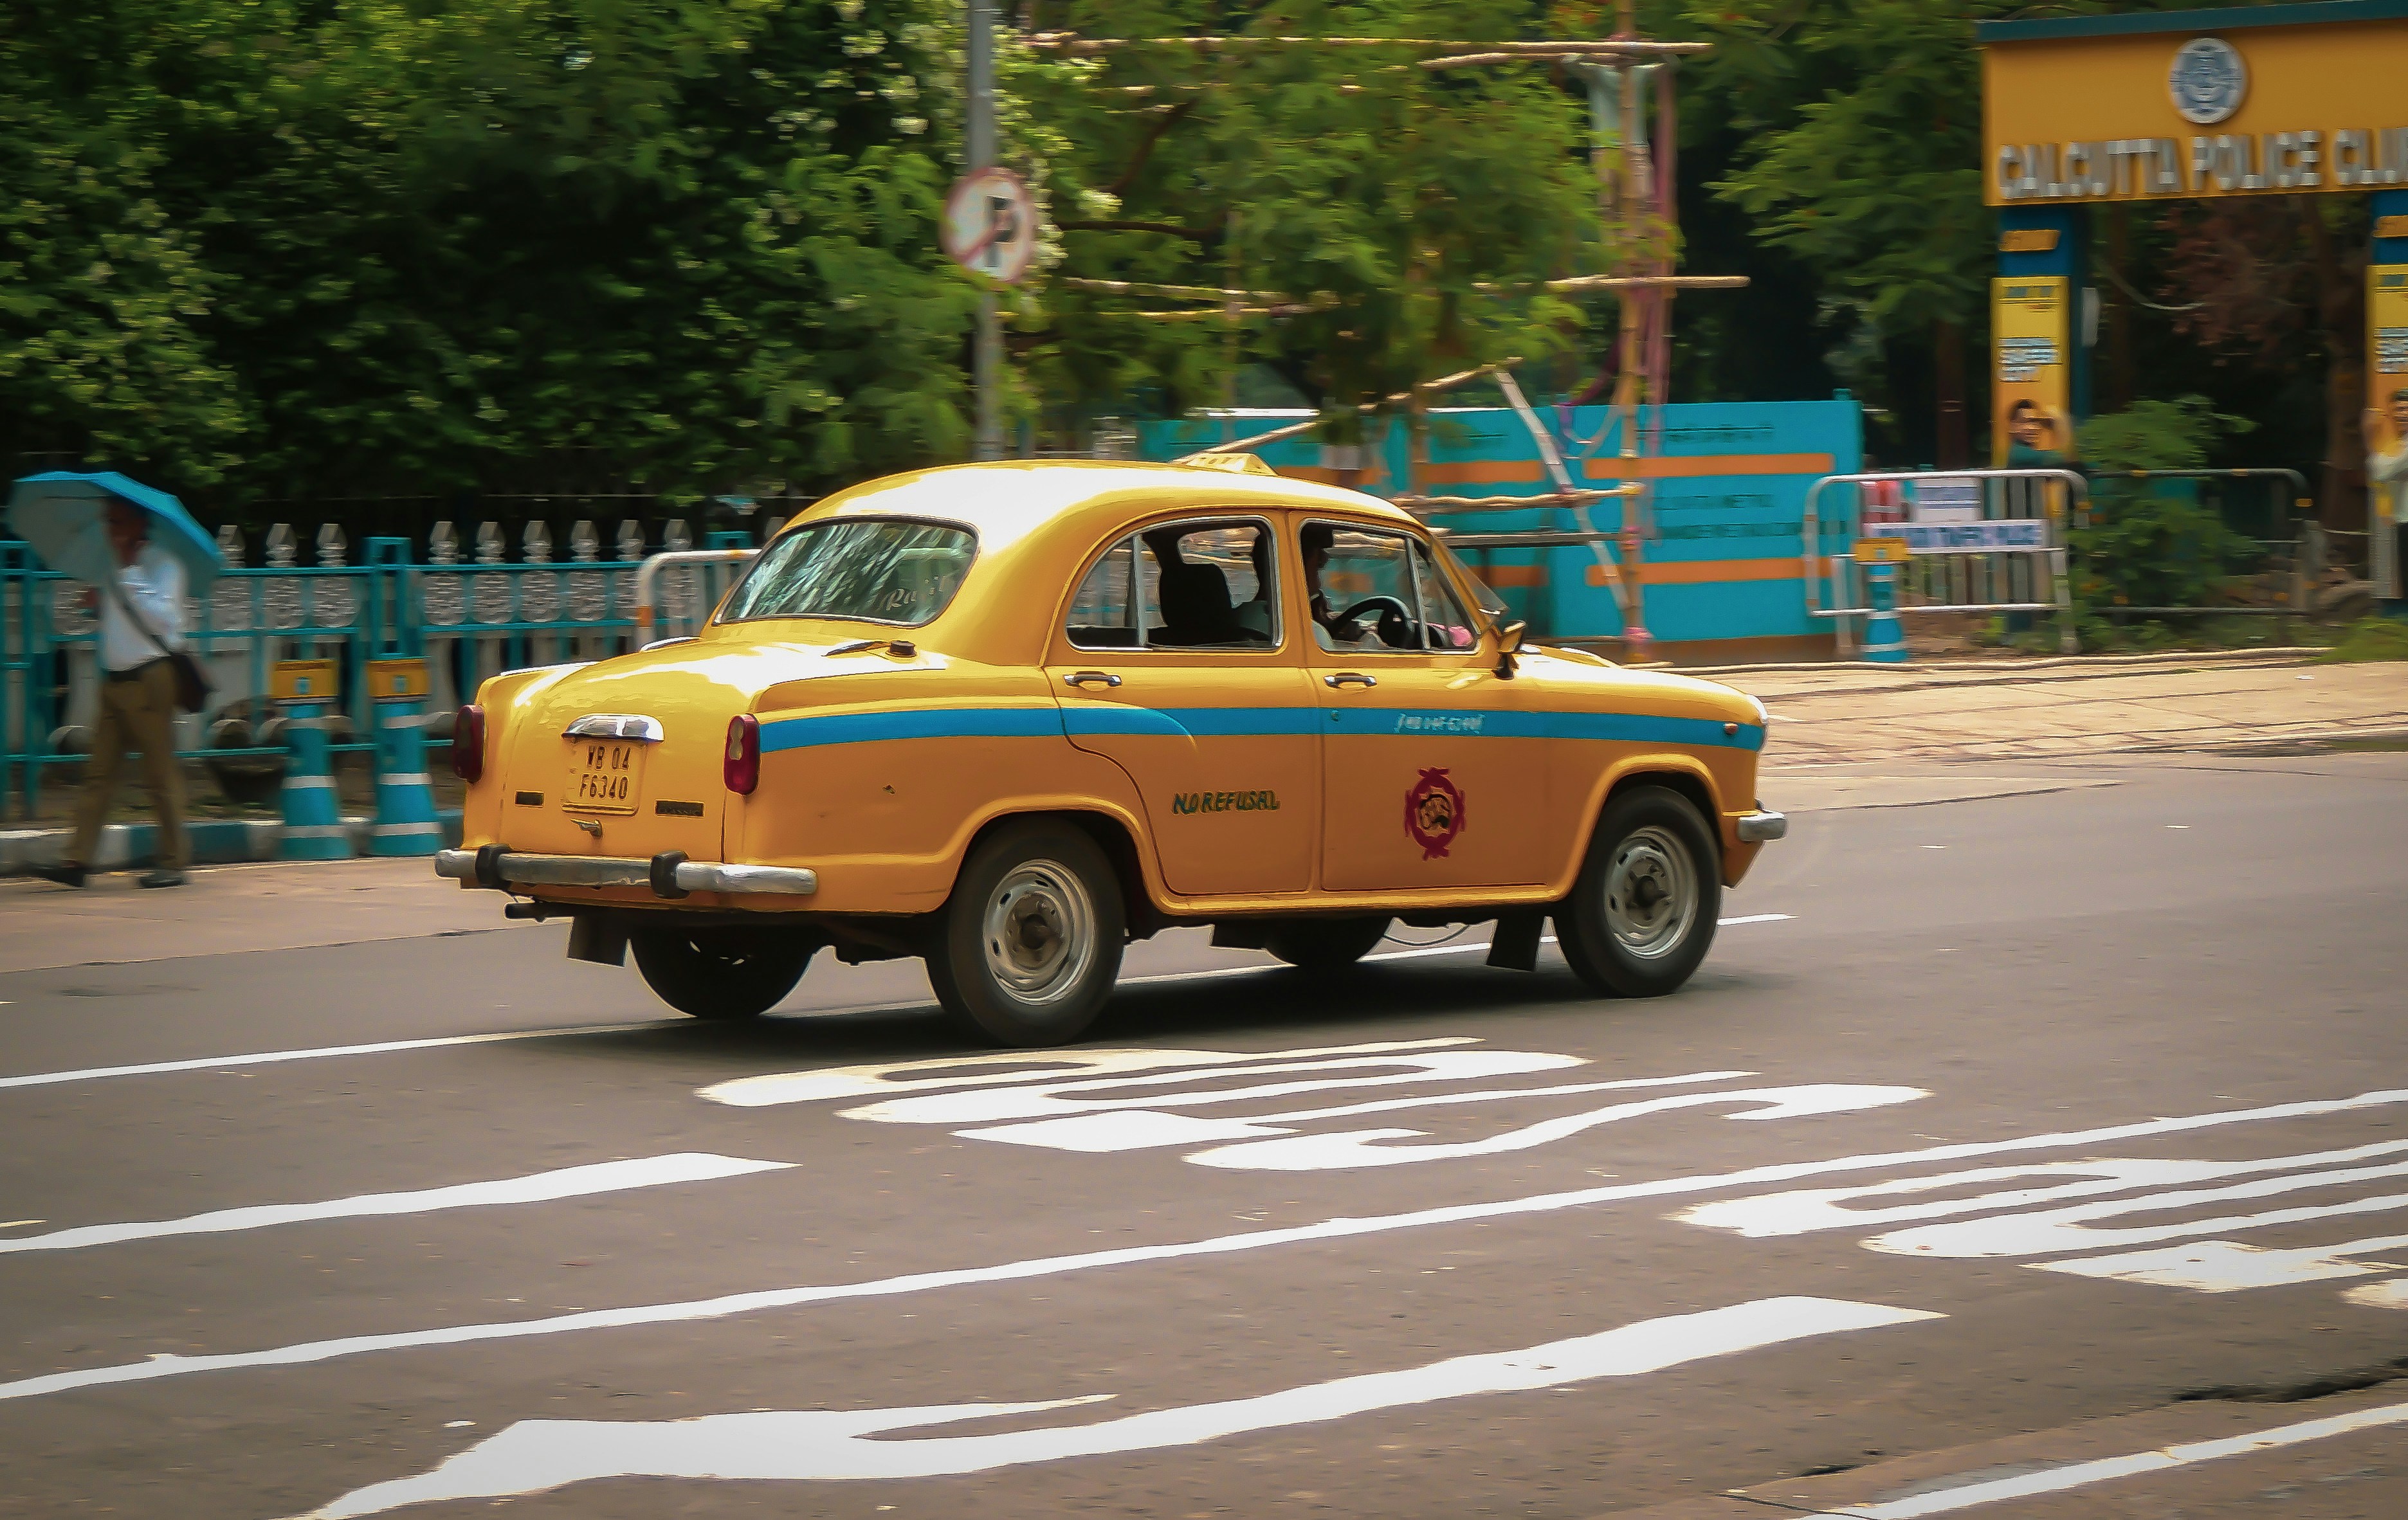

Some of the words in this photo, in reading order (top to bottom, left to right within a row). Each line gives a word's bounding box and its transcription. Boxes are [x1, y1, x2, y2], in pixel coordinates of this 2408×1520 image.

[1999, 139, 2182, 199] CALCUTTA
[2192, 129, 2321, 190] POLICE
[612, 746, 631, 770] 04
[579, 774, 628, 799] F6340
